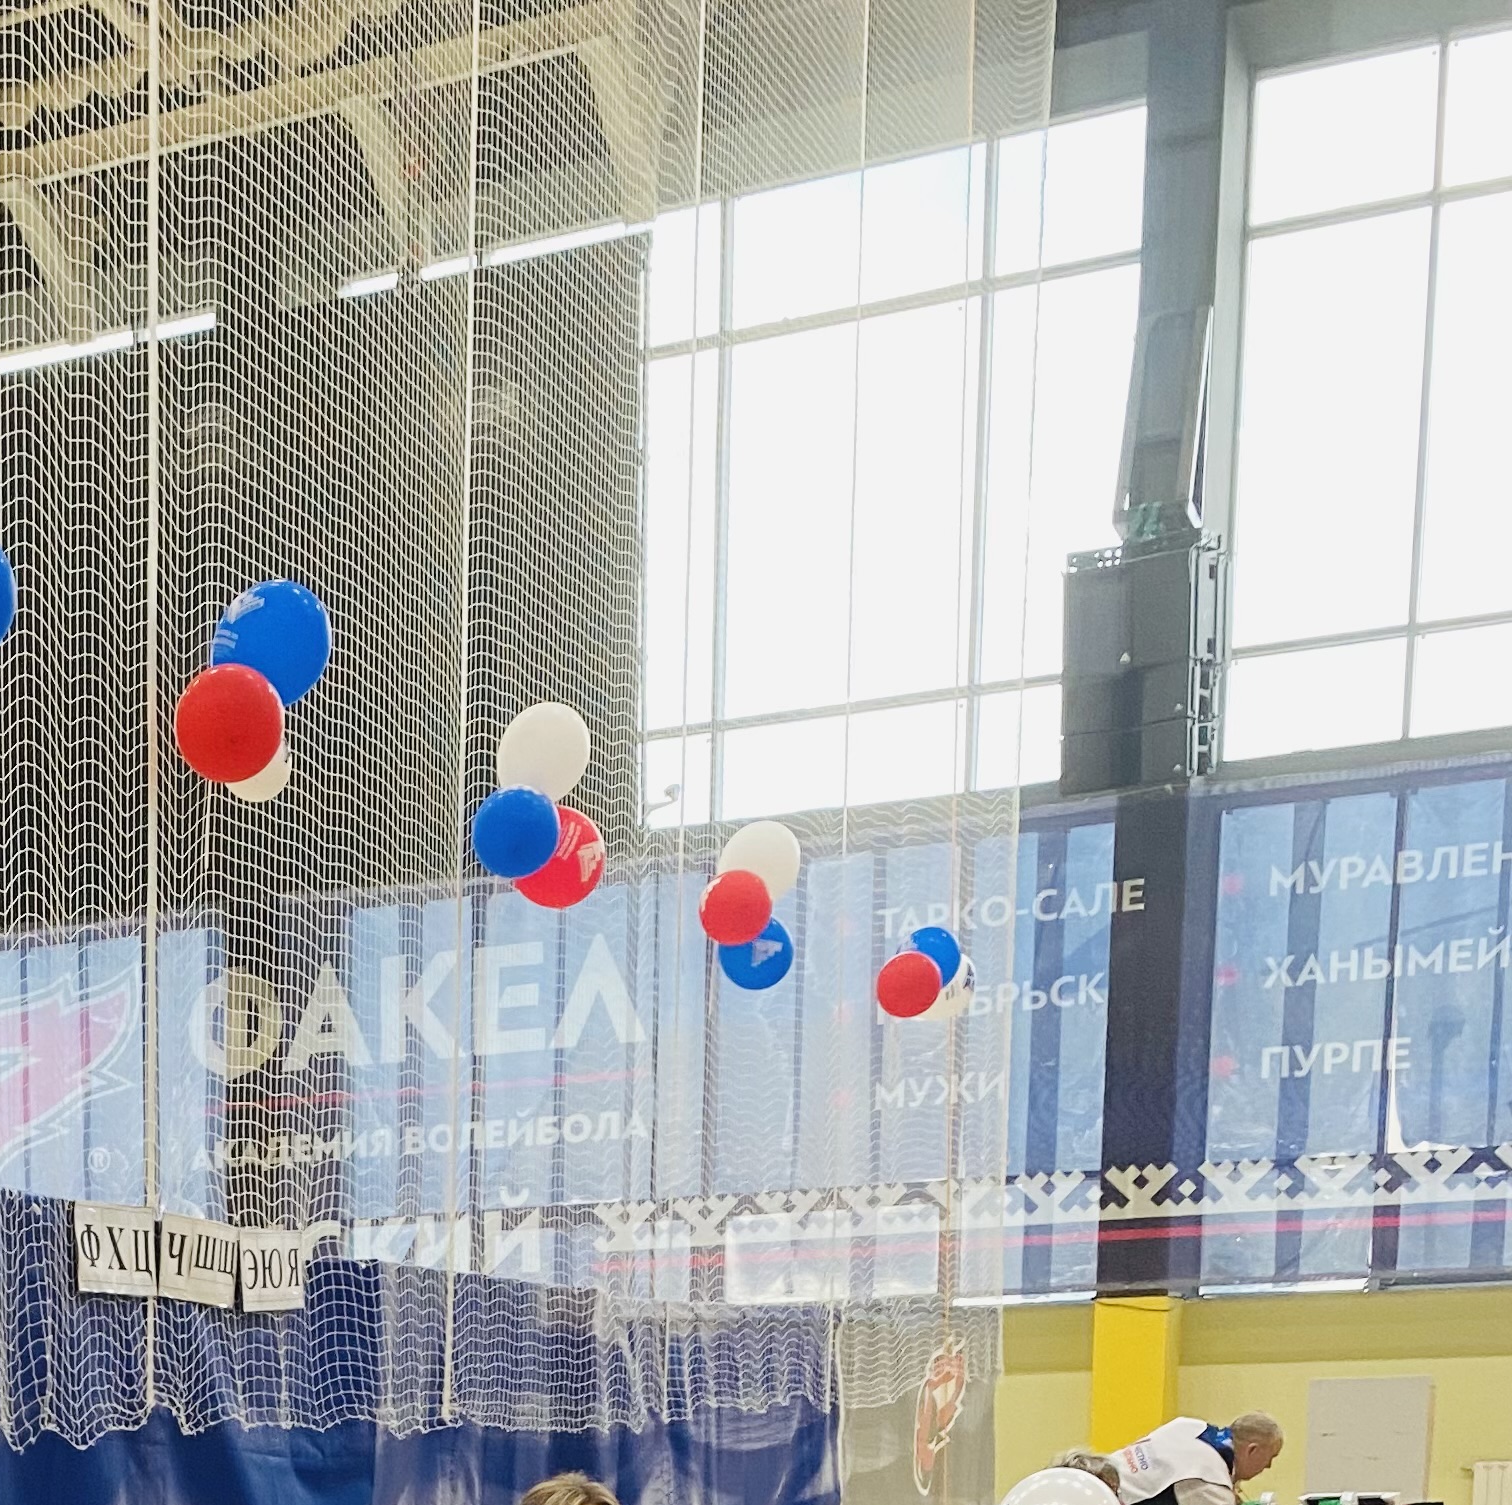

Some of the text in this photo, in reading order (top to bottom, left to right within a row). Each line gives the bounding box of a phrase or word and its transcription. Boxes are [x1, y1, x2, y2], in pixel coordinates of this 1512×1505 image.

[875, 878, 1146, 938] ТАРКО-САЛЕ
[1264, 924, 1511, 989] ХАНЫМЕЙ
[188, 933, 647, 1082] ФАКЕЛ
[1261, 1036, 1412, 1079] ПУРПЕ
[875, 1070, 1007, 1110] МУЖИ
[192, 1108, 649, 1171] АКАДЕМИЯ ВОЛЕЙБОЛА
